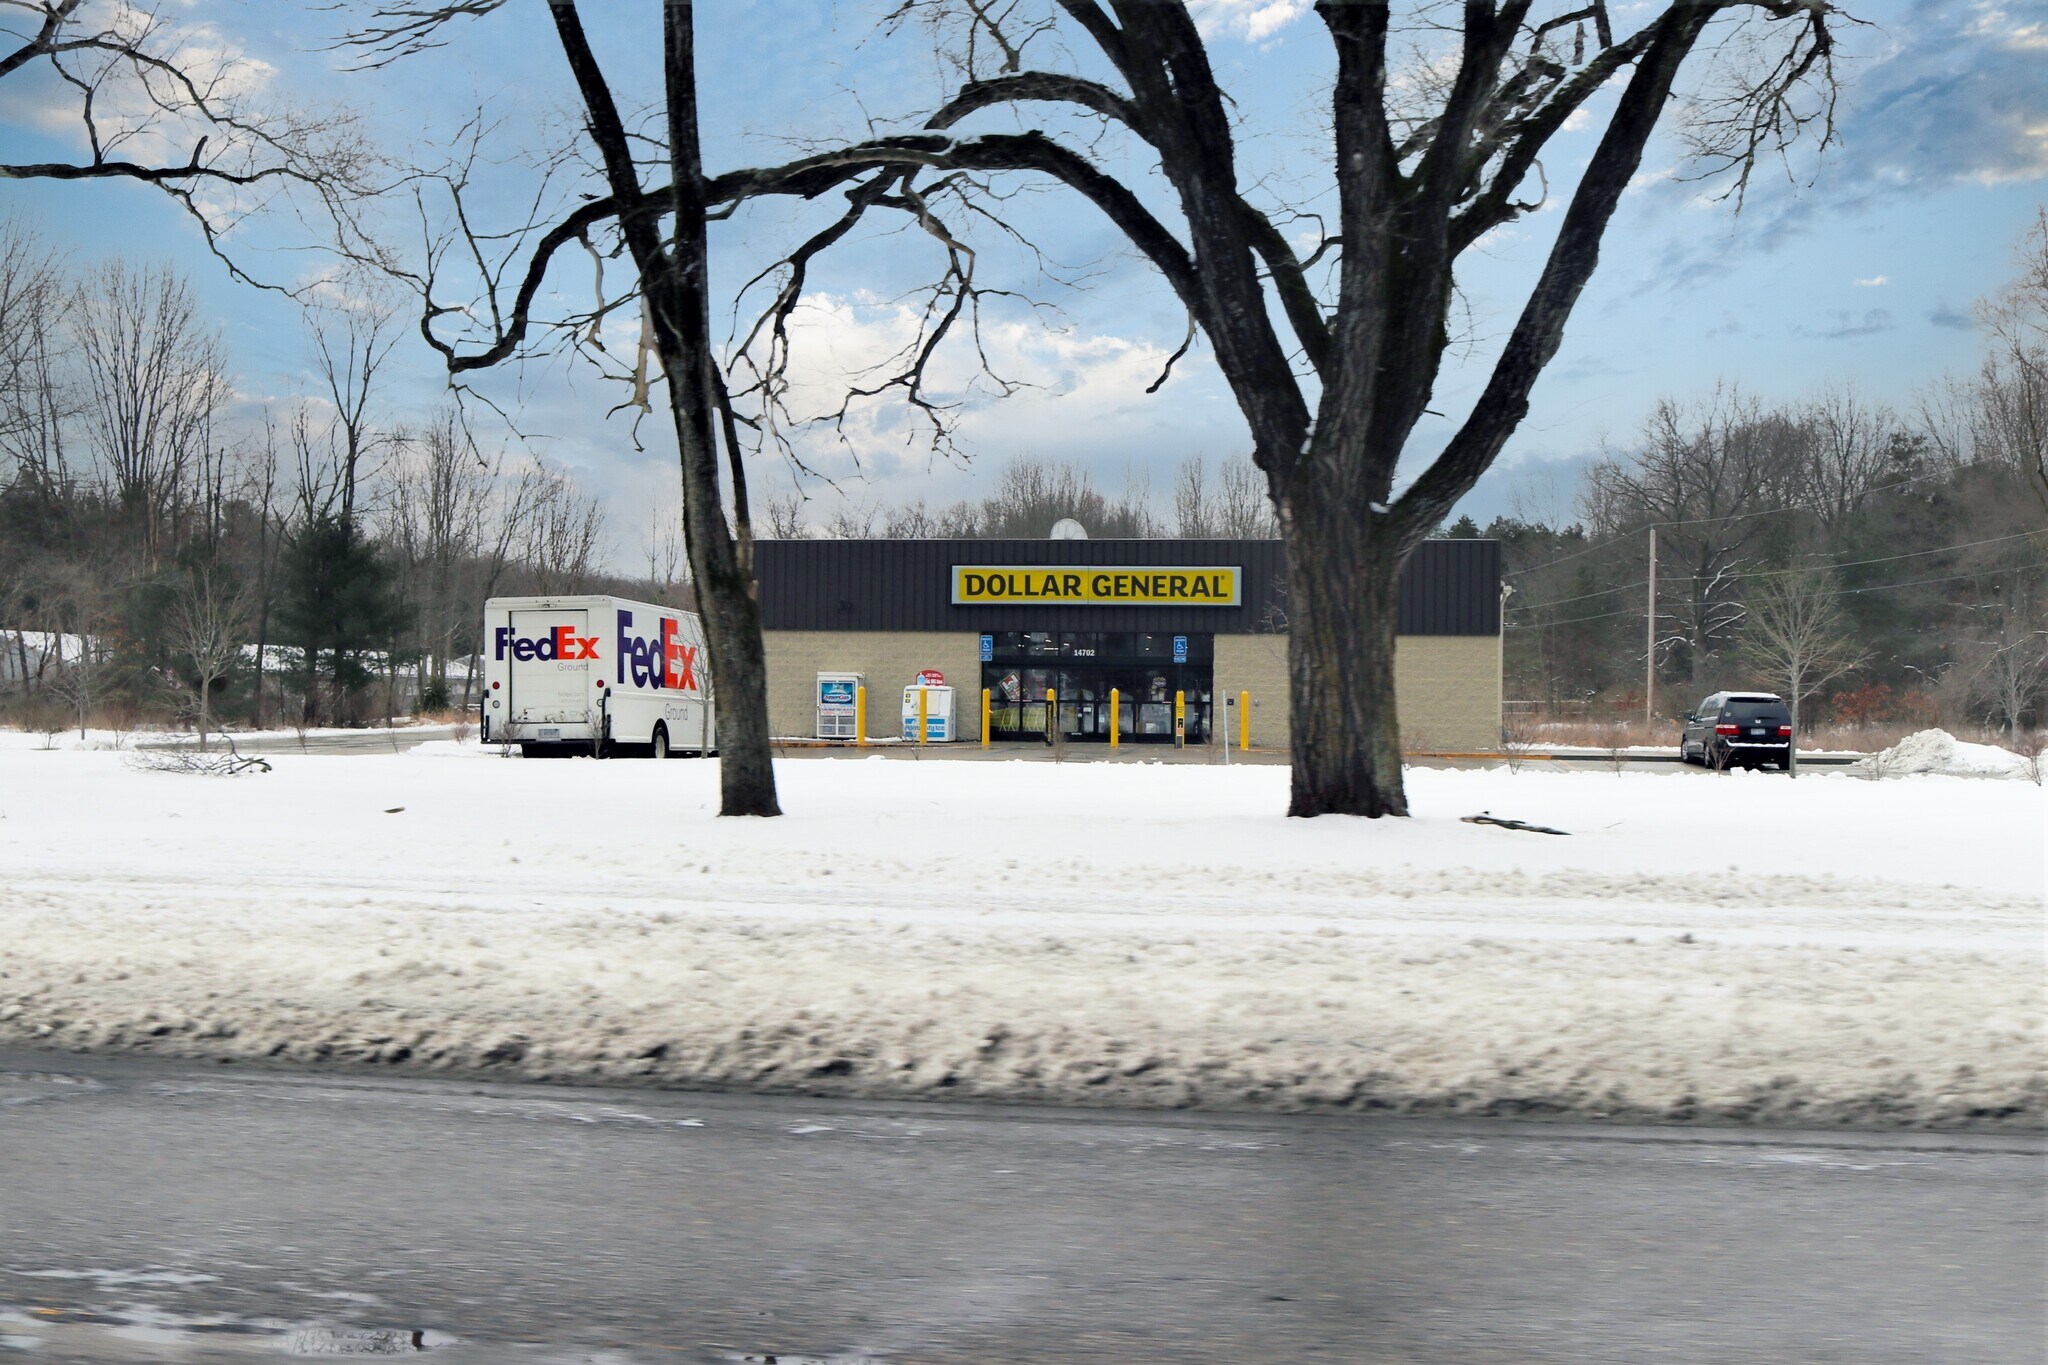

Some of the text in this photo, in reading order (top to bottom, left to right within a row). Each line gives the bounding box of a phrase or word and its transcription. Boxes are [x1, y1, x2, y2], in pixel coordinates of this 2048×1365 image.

[965, 574, 1228, 597] DOLLAR GENERAL
[495, 626, 600, 661] FedEx
[617, 609, 697, 691] FedEx
[1073, 648, 1095, 656] 14702
[557, 662, 589, 671] Ground
[664, 703, 688, 721] Ground
